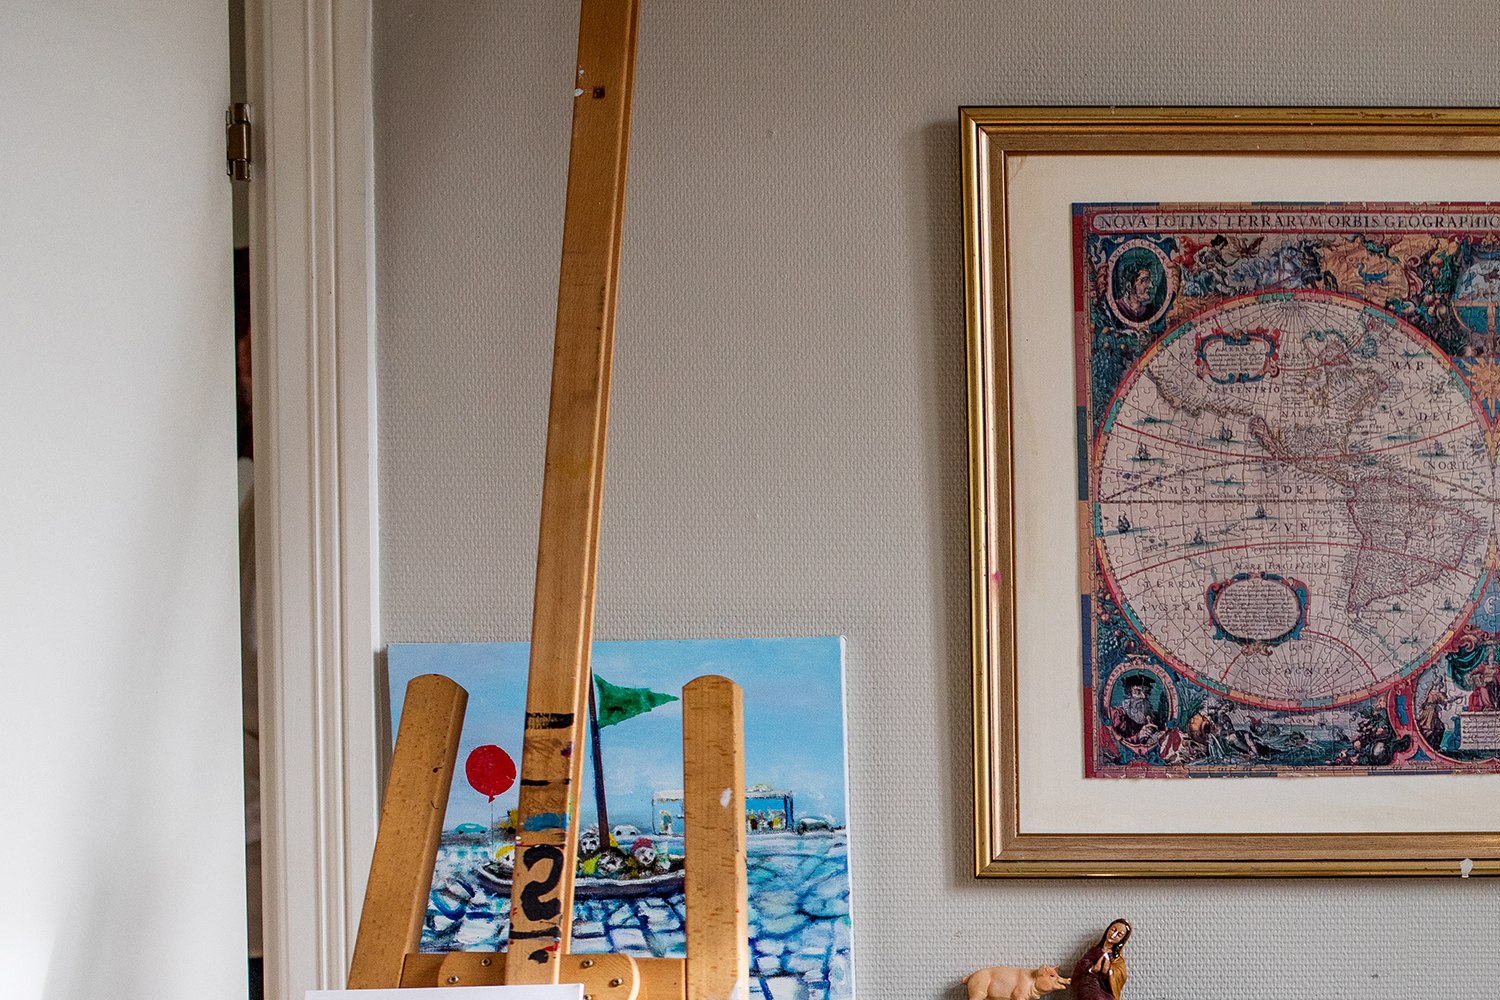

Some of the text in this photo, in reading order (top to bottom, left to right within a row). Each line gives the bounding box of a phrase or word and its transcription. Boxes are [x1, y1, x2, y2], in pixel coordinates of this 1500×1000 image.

[1099, 215, 1149, 229] NOVA
[1154, 215, 1218, 229] TOTIVS
[1225, 215, 1323, 229] TERRARVM
[1327, 214, 1380, 229] ORBIS
[1389, 361, 1425, 371] MAR
[1418, 411, 1453, 422] DEL
[1168, 485, 1317, 495] MAR DEL
[1269, 522, 1309, 532] ZVR
